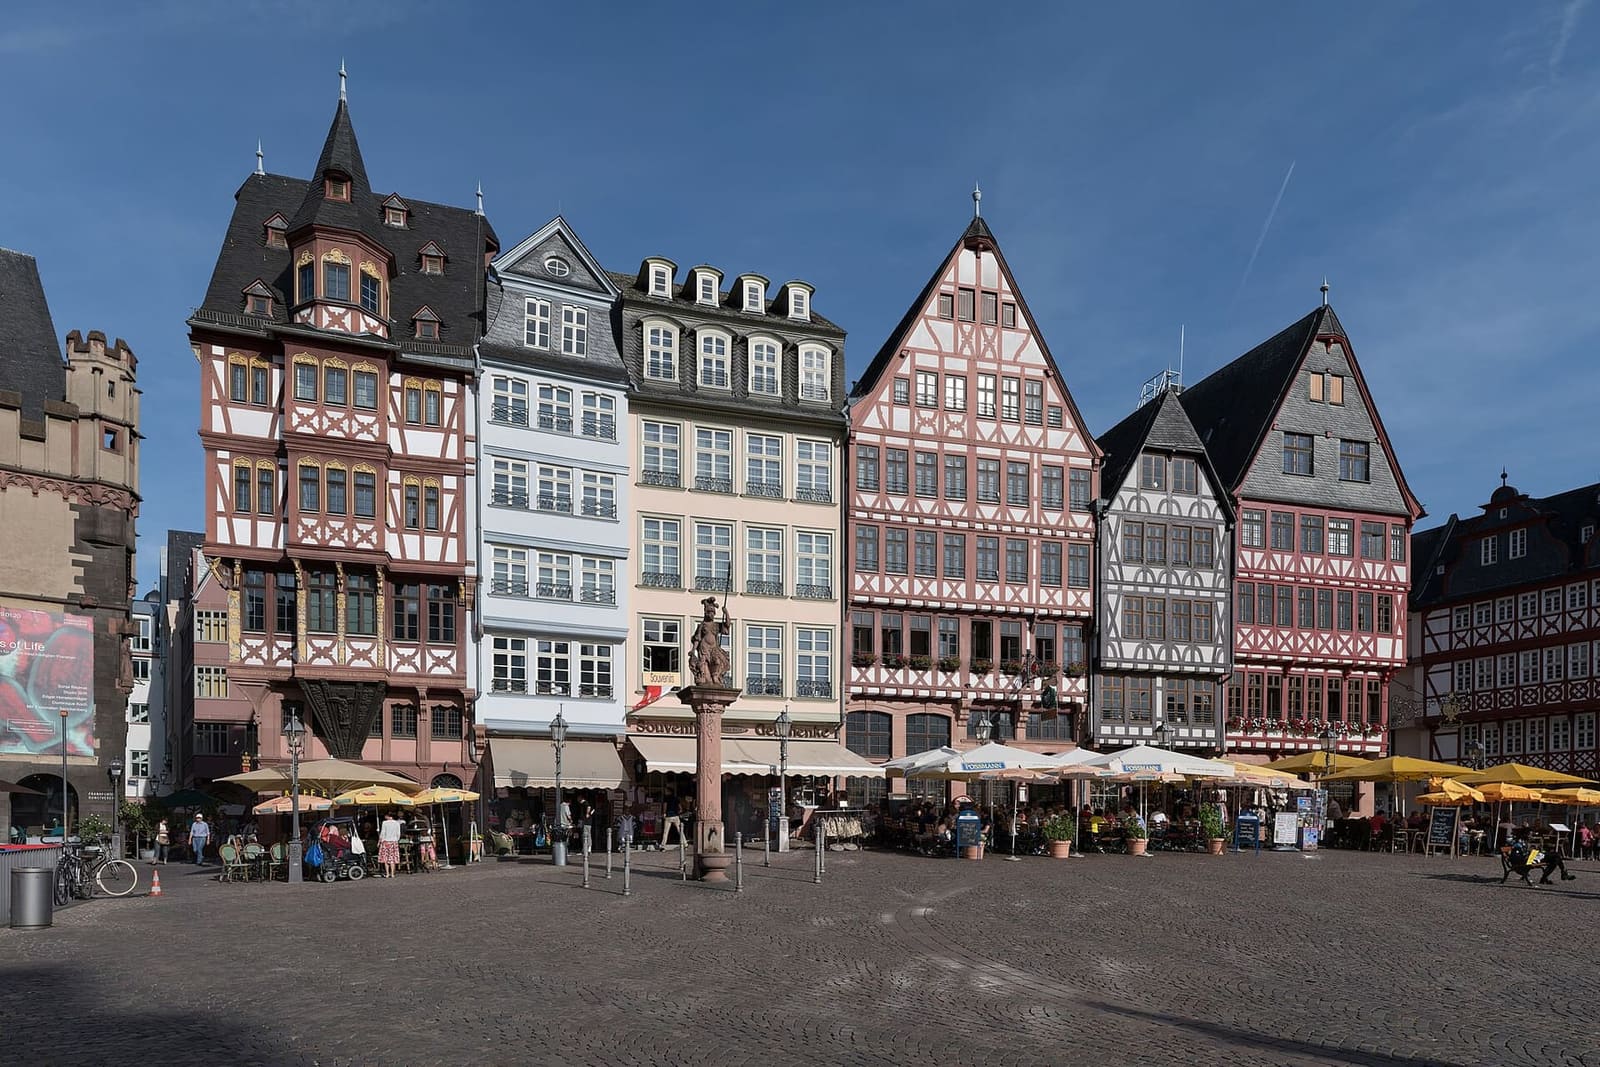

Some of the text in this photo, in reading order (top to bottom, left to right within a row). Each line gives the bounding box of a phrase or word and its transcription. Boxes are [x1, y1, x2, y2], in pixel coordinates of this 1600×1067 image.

[9, 641, 21, 649] of
[24, 641, 45, 652] Life
[636, 721, 697, 735] Souveni
